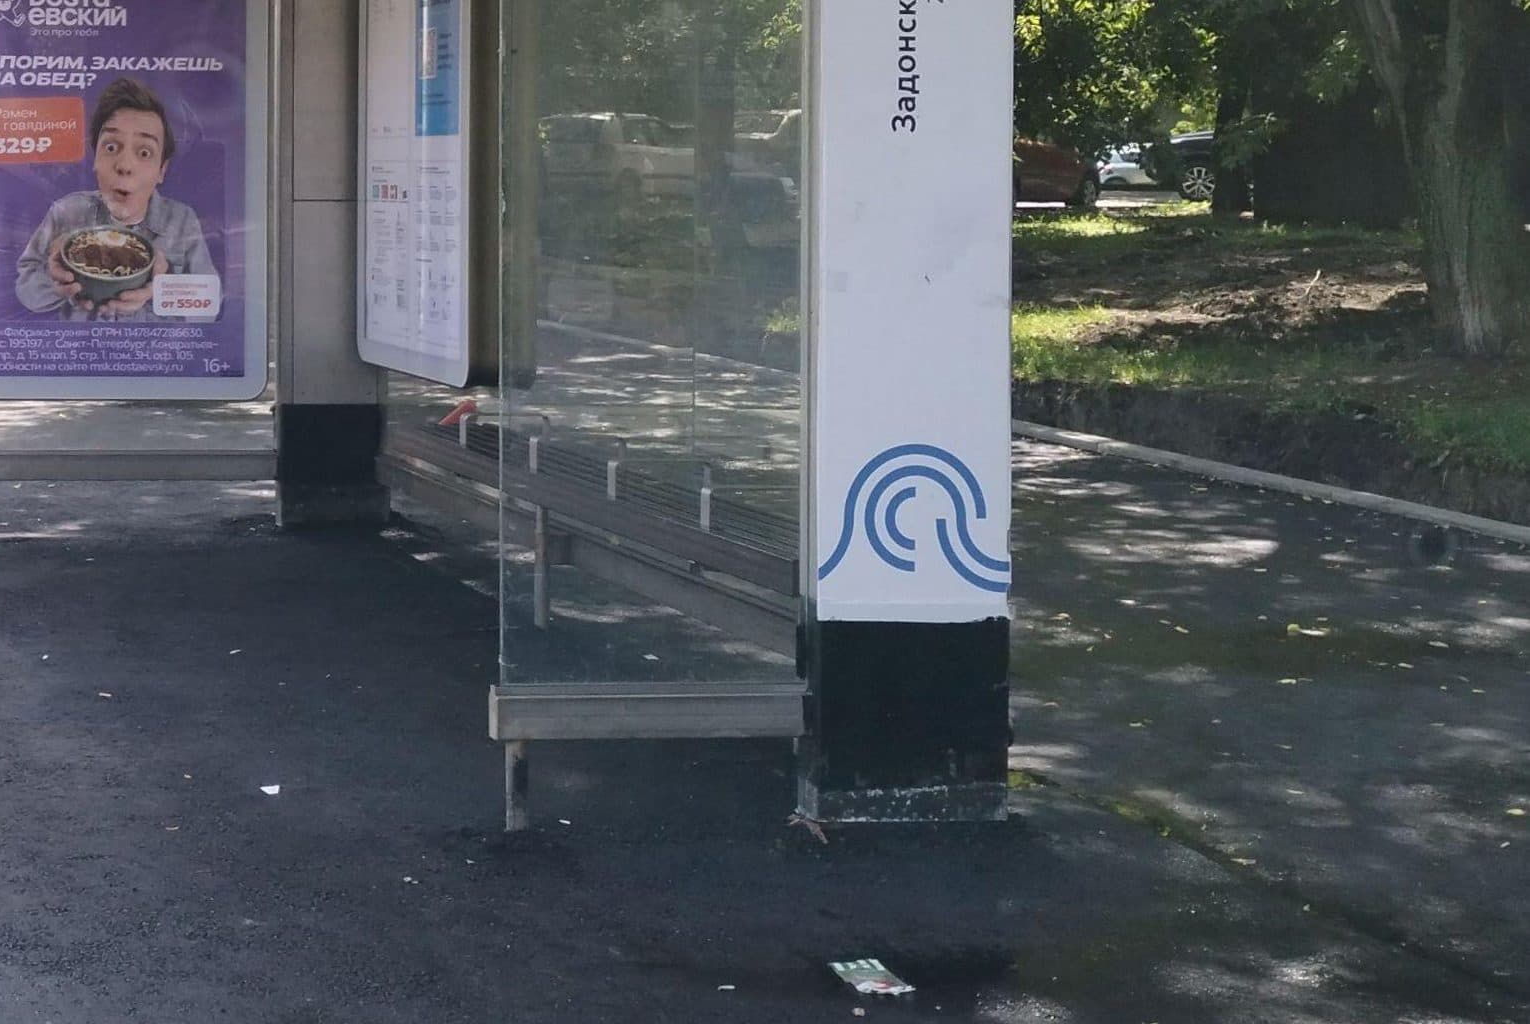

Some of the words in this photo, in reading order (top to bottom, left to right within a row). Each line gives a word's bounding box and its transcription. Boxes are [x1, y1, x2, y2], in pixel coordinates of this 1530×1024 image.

[51, 29, 72, 39] про
[90, 57, 224, 72] ЗАКАЖЕШЬ
[20, 72, 97, 90] ОБЕД?
[3, 118, 77, 134] говядиной
[202, 357, 231, 373] 16+
